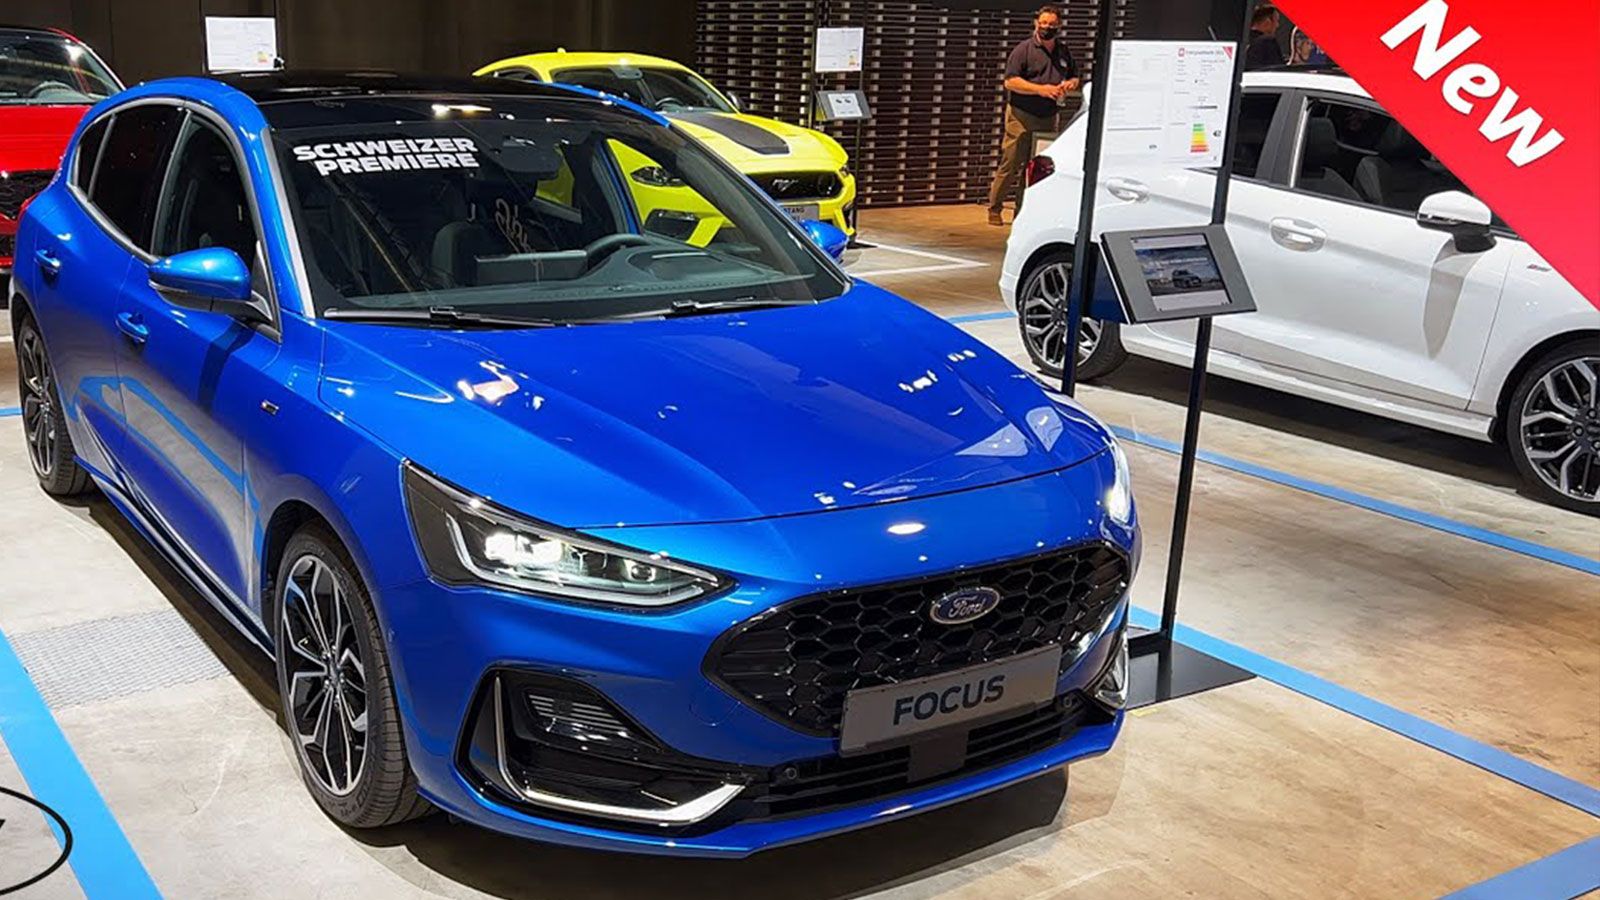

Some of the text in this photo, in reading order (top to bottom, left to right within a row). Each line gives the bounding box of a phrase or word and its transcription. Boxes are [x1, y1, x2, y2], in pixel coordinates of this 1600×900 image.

[293, 138, 478, 160] SCHWEIZER
[314, 153, 479, 176] PREMIERE
[948, 596, 987, 618] Ford
[893, 675, 1005, 725] FOCUS
